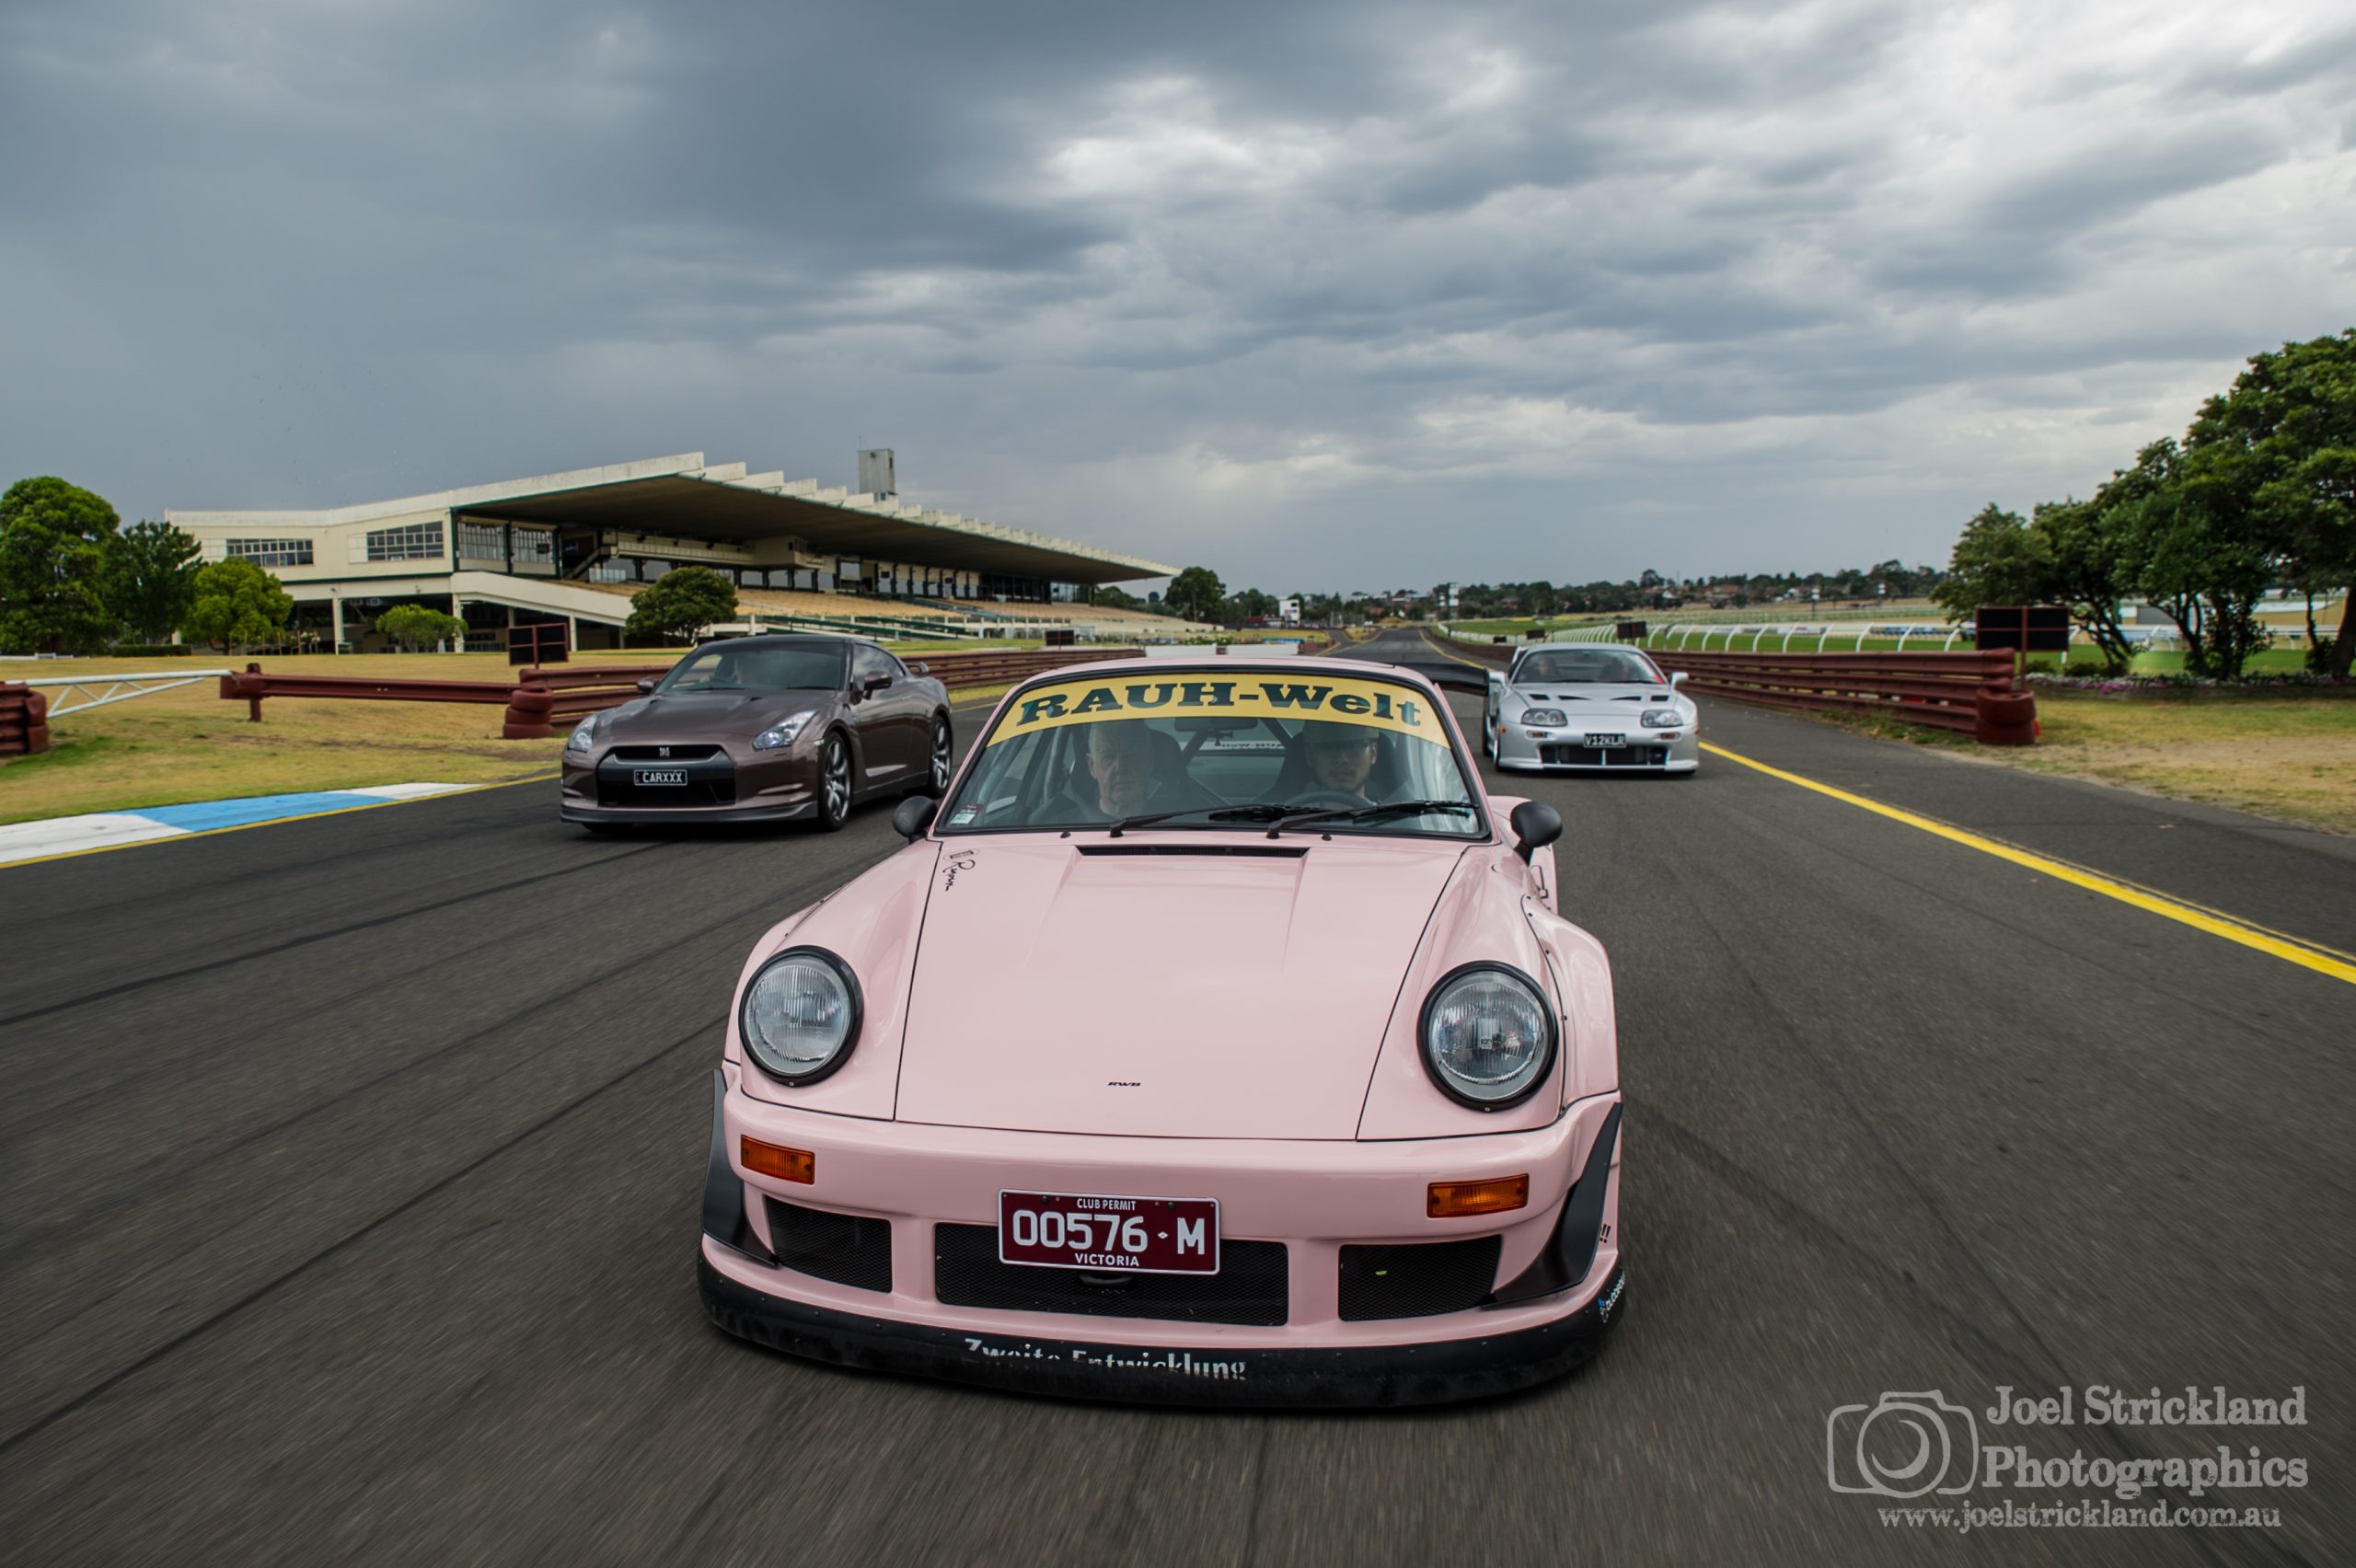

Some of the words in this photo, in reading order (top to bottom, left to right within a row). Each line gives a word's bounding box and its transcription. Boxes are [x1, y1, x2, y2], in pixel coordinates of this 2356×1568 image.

[1016, 682, 1421, 726] RAUH-Welt
[642, 772, 683, 783] CARXXX
[1077, 1198, 1101, 1210] CLUB
[1103, 1199, 1137, 1211] PERMIT
[1012, 1209, 1148, 1253] 00576
[1177, 1216, 1205, 1255] M
[1075, 1252, 1139, 1267] VICTORIA
